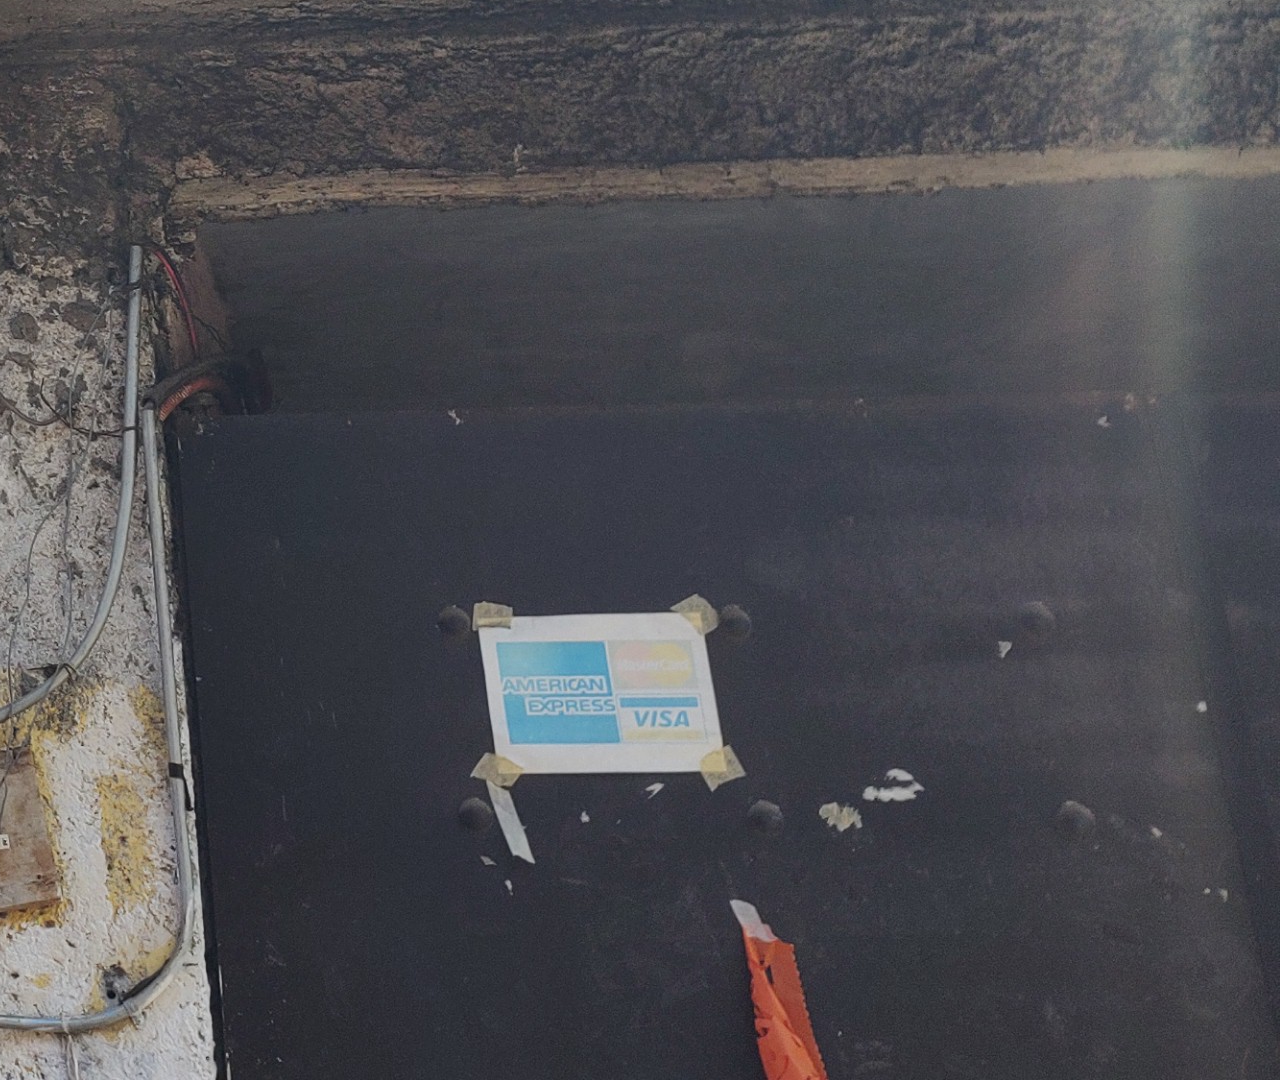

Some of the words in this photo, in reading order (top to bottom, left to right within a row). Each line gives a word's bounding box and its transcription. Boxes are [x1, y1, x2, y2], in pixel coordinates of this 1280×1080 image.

[502, 676, 605, 692] AMERICAN
[528, 698, 616, 713] EXPRESS
[634, 709, 690, 728] VISA
